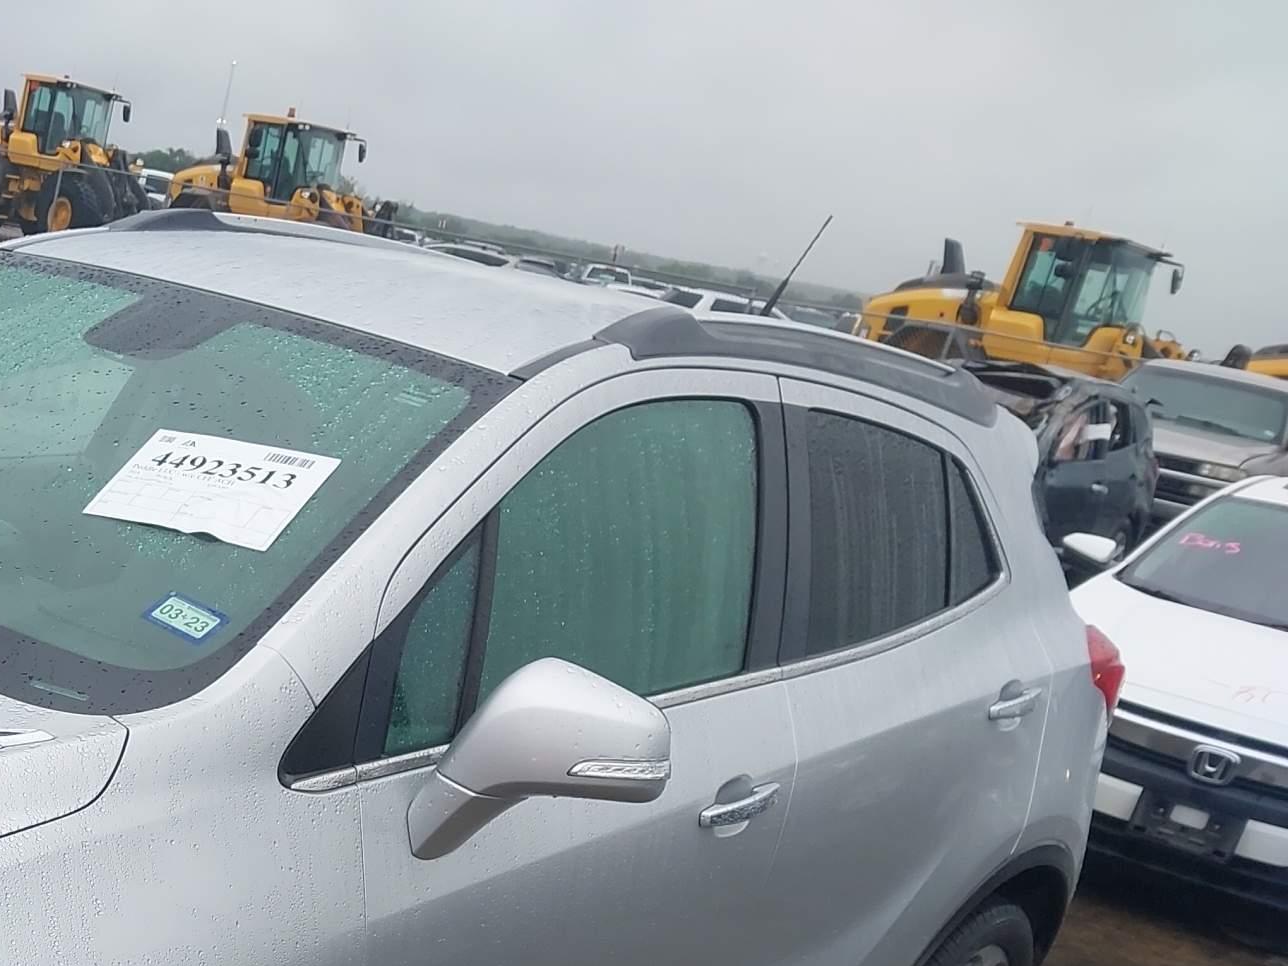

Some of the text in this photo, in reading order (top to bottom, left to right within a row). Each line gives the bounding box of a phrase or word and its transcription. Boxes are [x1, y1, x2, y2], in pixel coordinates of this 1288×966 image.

[151, 451, 297, 489] 44923513
[159, 603, 210, 633] 03 23
